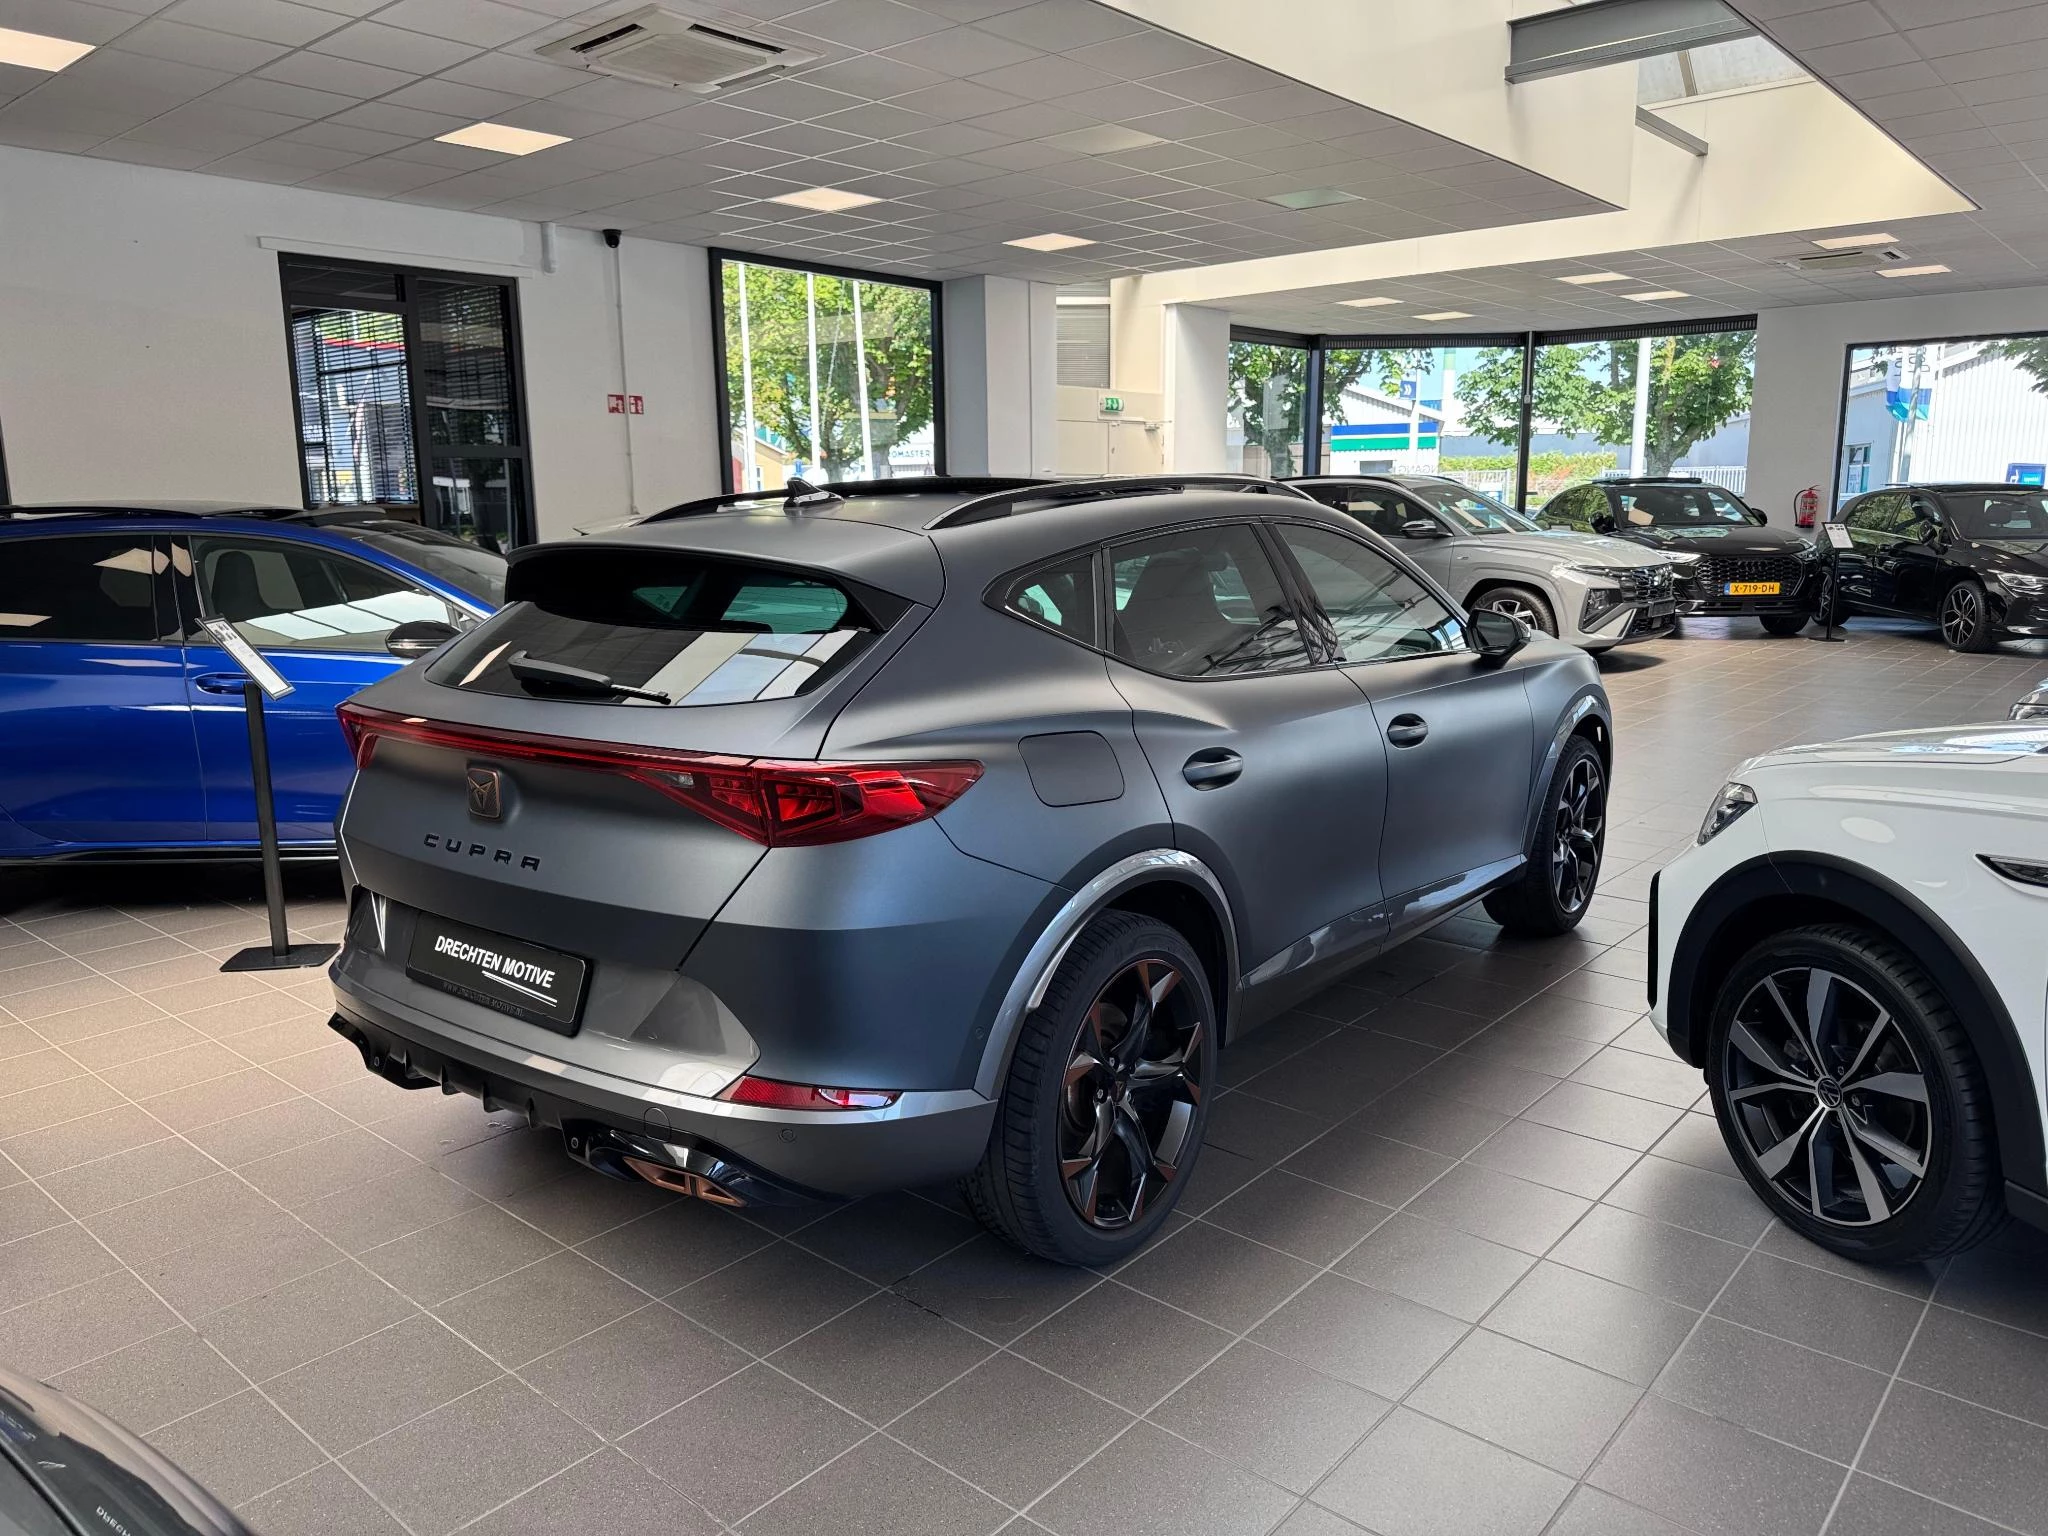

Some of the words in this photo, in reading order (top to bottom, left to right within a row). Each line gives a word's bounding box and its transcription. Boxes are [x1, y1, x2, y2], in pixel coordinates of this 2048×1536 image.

[891, 449, 931, 458] OMASTER
[1733, 584, 1775, 593] X-719-DH
[424, 833, 540, 871] CUPRA
[434, 935, 503, 971] DRECHTEN
[501, 957, 556, 989] MOTIVE
